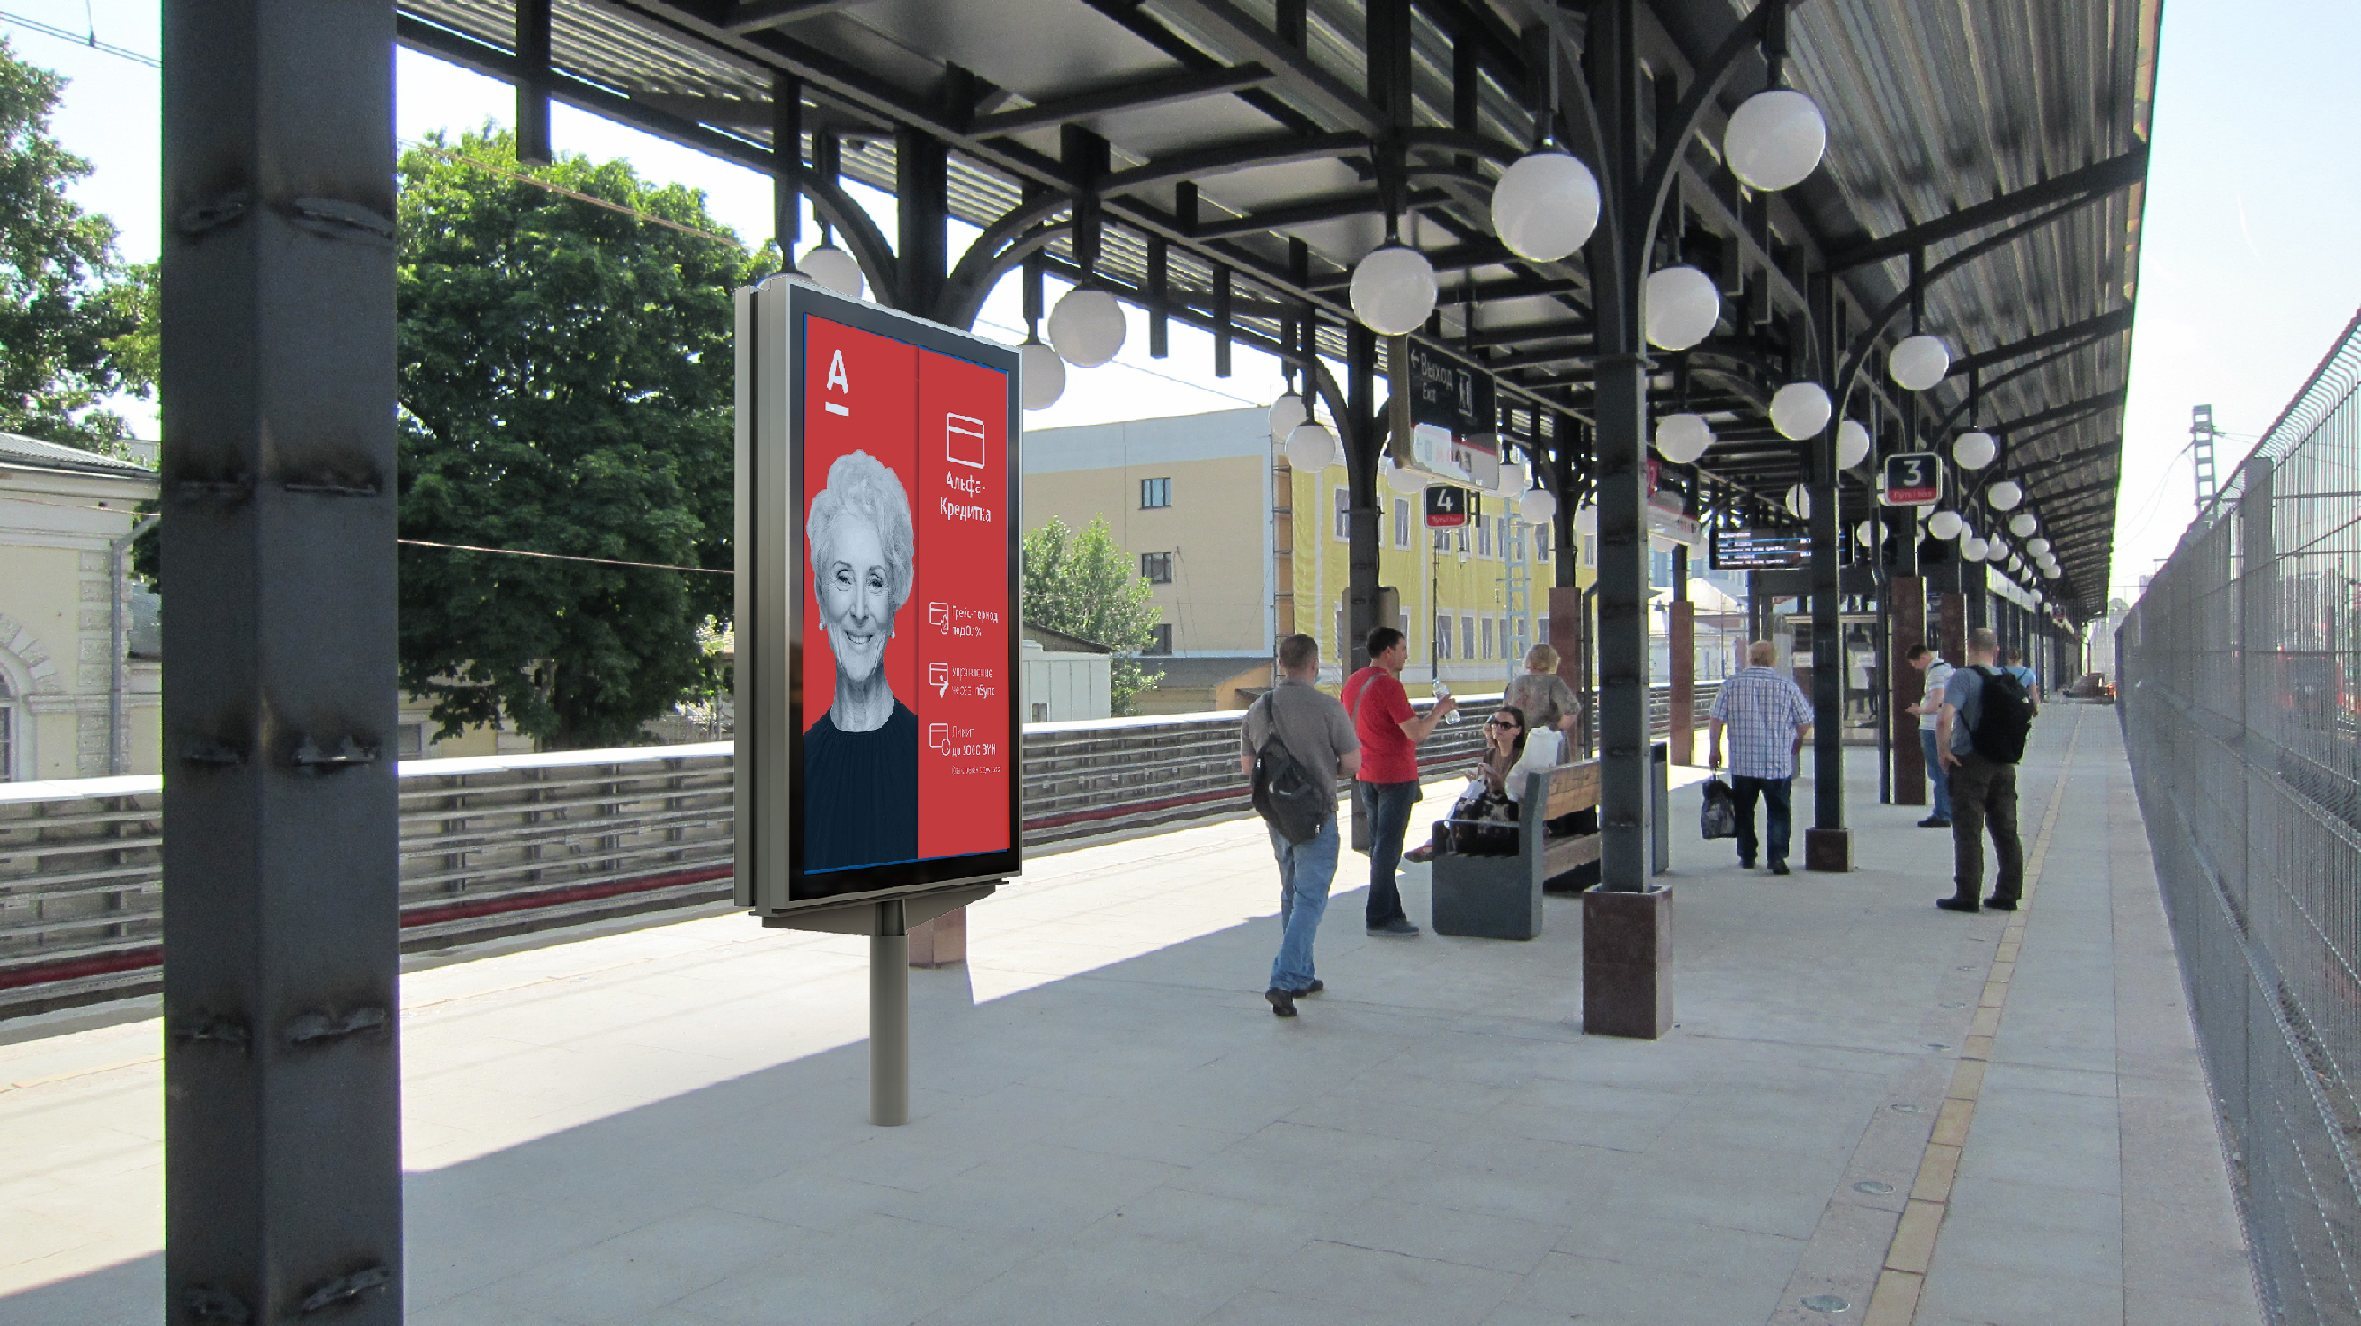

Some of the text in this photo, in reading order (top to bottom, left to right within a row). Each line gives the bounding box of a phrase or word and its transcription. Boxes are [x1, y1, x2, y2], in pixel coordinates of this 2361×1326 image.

[1420, 352, 1454, 392] Выход
[1903, 460, 1921, 487] 3
[940, 496, 992, 522] Кредитка
[1436, 488, 1454, 512] 4
